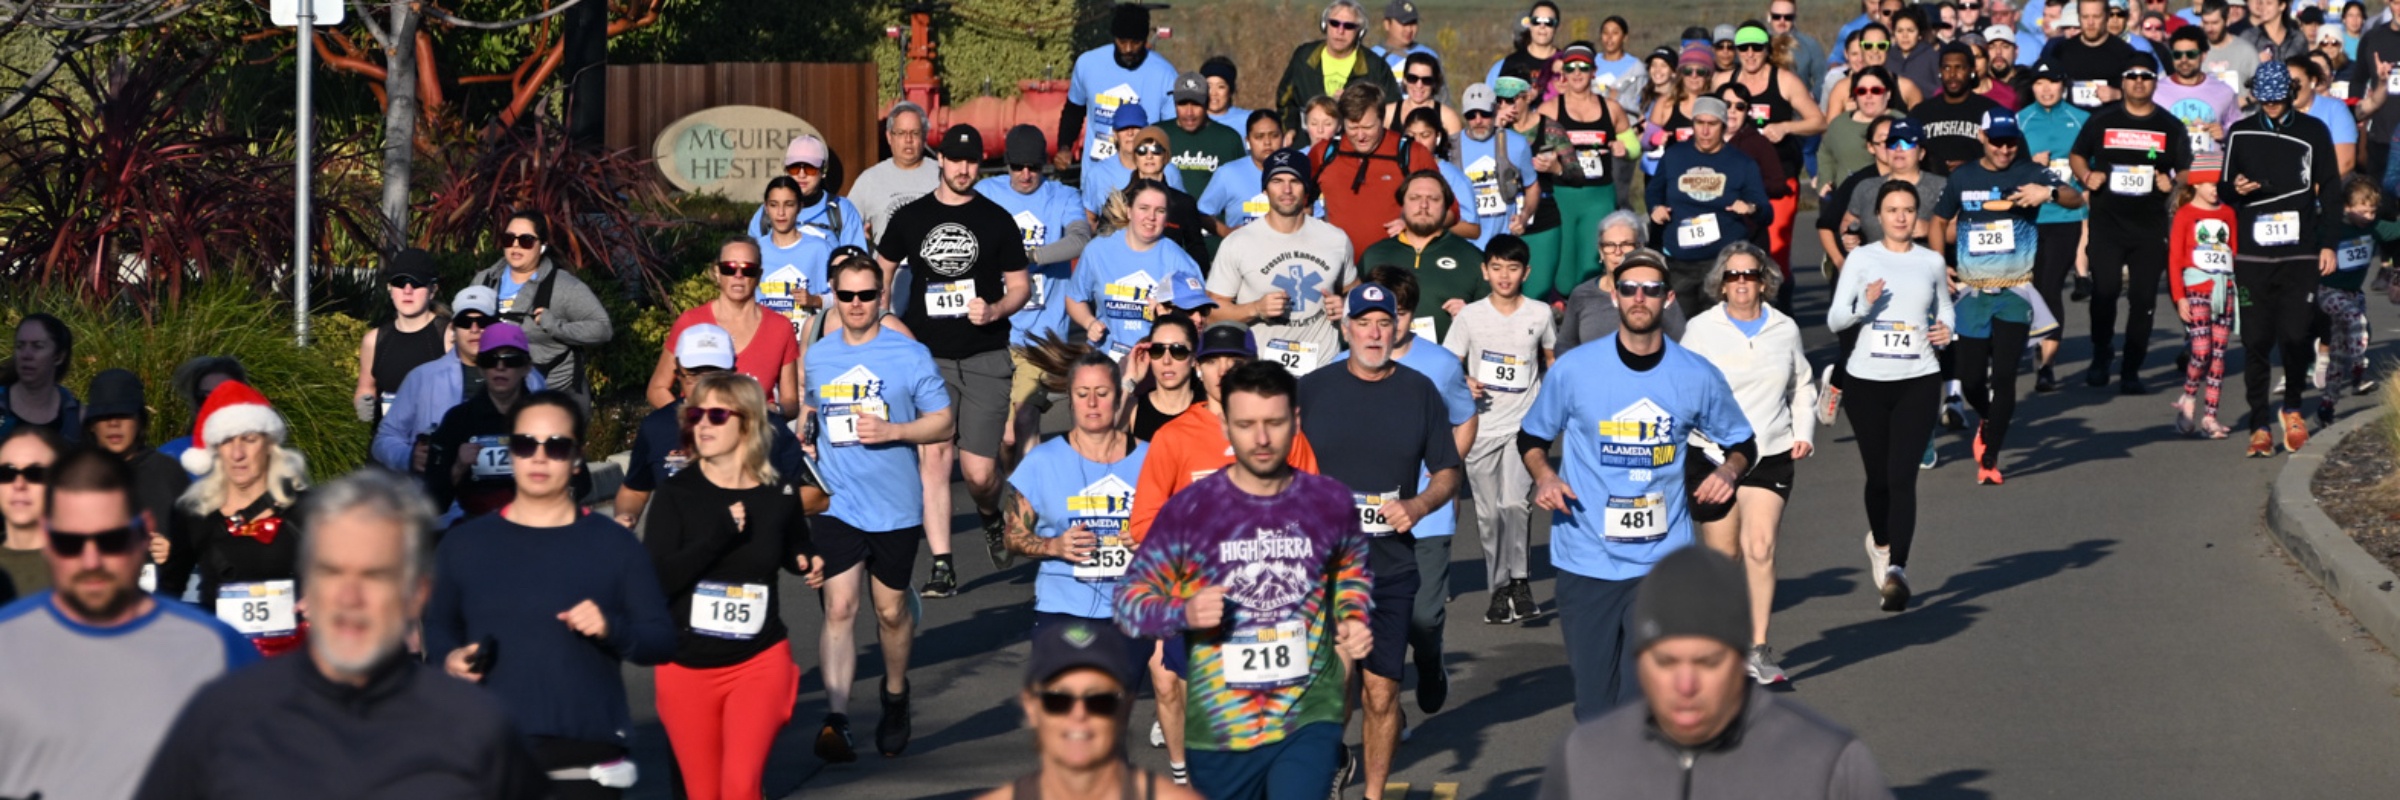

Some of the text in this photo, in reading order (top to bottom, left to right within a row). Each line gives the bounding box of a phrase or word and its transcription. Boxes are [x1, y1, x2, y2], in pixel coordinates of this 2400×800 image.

[1922, 120, 1981, 139] YMSHAR
[690, 157, 785, 179] HESTE
[1171, 150, 1219, 172] erkeley
[2120, 174, 2145, 187] 350
[1689, 225, 1705, 239] 18
[2265, 223, 2288, 236] 311
[1977, 232, 2003, 245] 328
[2204, 252, 2227, 264] 324
[2346, 246, 2368, 262] 325
[937, 293, 964, 309] 419
[1105, 301, 1143, 312] ALAMEDA
[1883, 333, 1911, 347] 174
[1281, 352, 1300, 369] 92
[1495, 366, 1516, 381] 93
[1602, 444, 1676, 467] ALAMEDA RUN
[1628, 469, 1652, 481] 2024
[1620, 509, 1654, 529] 481
[1220, 536, 1314, 563] HIGH SIERRA
[242, 601, 270, 622] 85
[710, 600, 751, 624] 185
[1257, 628, 1277, 643] RUN
[1241, 644, 1291, 671] 218
